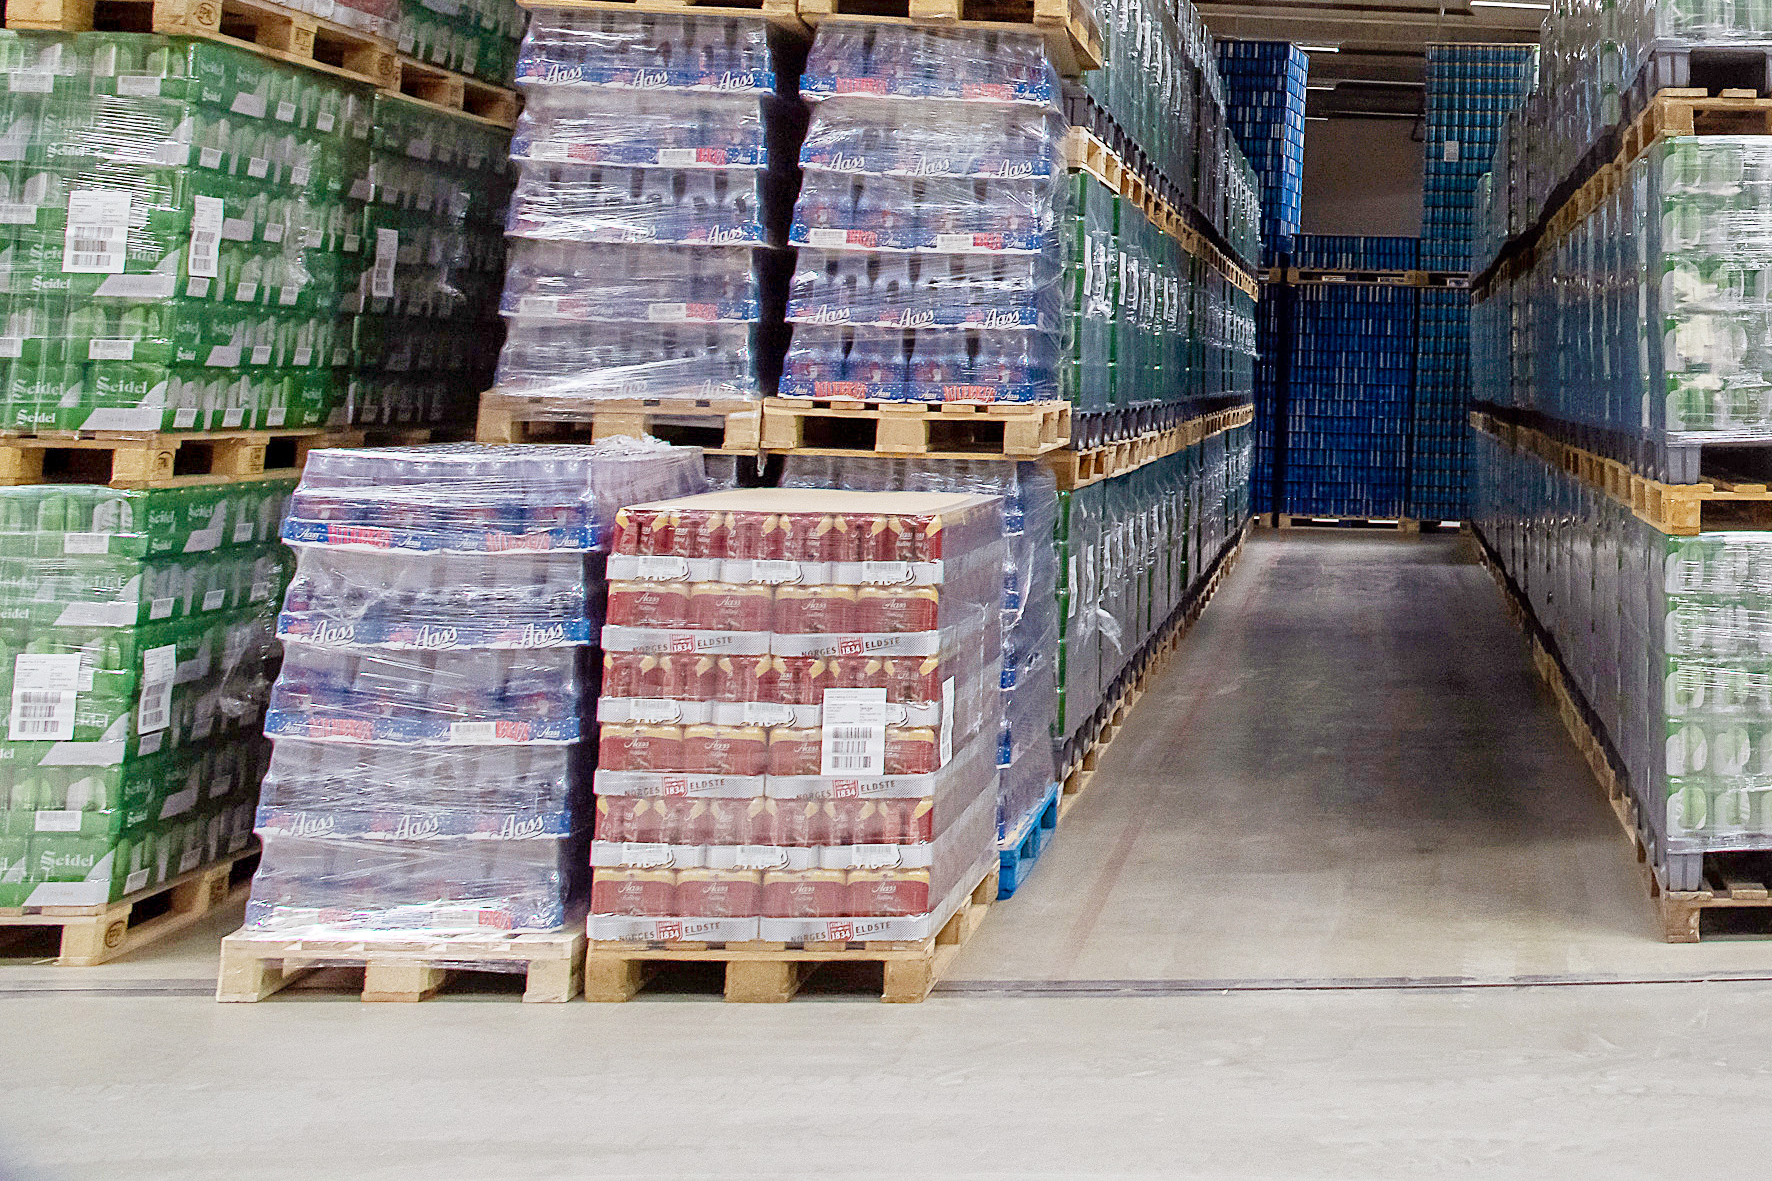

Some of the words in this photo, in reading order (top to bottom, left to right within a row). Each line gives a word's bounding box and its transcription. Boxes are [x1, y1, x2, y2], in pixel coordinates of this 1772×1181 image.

[546, 64, 583, 83] Aass
[632, 69, 669, 89] Aass
[718, 71, 755, 92] Aass
[830, 152, 865, 171] Aass
[914, 157, 950, 176] Aass
[999, 159, 1033, 178] Aass
[708, 225, 744, 244] Aass
[31, 276, 71, 292] Seidel
[815, 305, 850, 323] Aass
[901, 307, 935, 327] Aass
[986, 309, 1021, 328] Aass
[13, 378, 66, 401] Seidel
[96, 373, 148, 397] Seidel
[16, 407, 56, 425] Seidel
[295, 529, 320, 539] Aass
[401, 535, 422, 548] Aass
[559, 536, 580, 548] Aass
[635, 593, 660, 604] Aass
[716, 596, 741, 607] Aass
[801, 599, 827, 610] Aass
[882, 599, 907, 610] Aass
[308, 620, 356, 644] Aass
[410, 624, 459, 649] Aass
[518, 622, 565, 648] Aass
[672, 643, 692, 652] 1834
[697, 636, 733, 647] ELDSTE
[841, 645, 861, 655] 1834
[866, 637, 900, 648] ELDSTE
[278, 721, 301, 733] Aass
[380, 727, 404, 739] Aass
[538, 726, 561, 738] Aass
[624, 739, 650, 749] Aass
[704, 740, 730, 750] Aass
[794, 743, 819, 753] Aass
[665, 786, 686, 796] 1834
[690, 779, 726, 789] ELDSTE
[836, 789, 856, 798] 1834
[861, 781, 896, 792] ELDSTE
[290, 811, 336, 838] Aass
[395, 814, 441, 840] Aass
[501, 814, 546, 840] Aass
[40, 850, 94, 871] Seidel
[618, 882, 644, 893] Aass
[703, 882, 728, 893] Aass
[790, 883, 815, 894] Aass
[872, 882, 897, 893] Aass
[660, 930, 680, 939] 1834
[685, 922, 720, 933] ELDSTE
[831, 930, 850, 940] 1834
[856, 922, 891, 933] ELDSTE
